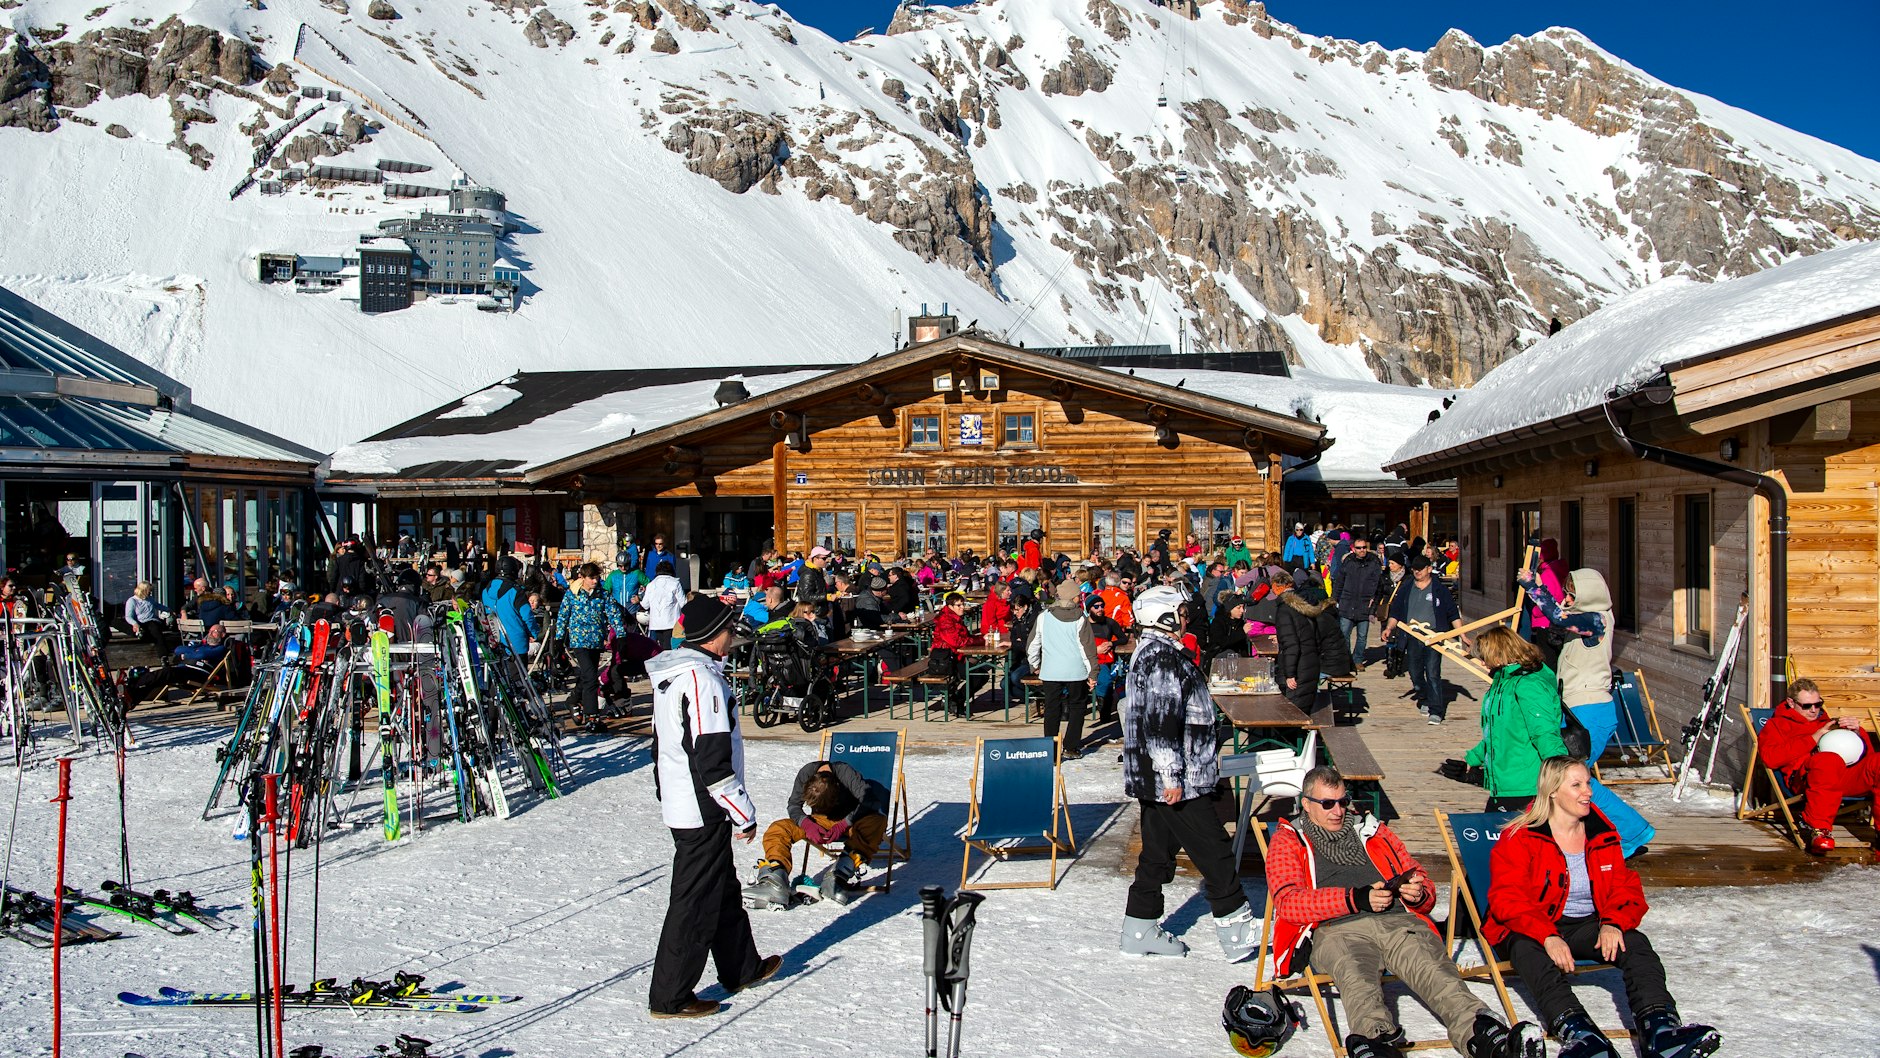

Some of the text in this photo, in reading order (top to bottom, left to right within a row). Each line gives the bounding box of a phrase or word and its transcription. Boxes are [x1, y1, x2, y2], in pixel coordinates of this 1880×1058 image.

[868, 468, 925, 485] SONN
[936, 466, 995, 485] ALPIN
[850, 744, 891, 753] Lufthansa
[1005, 750, 1048, 760] Lufthansa
